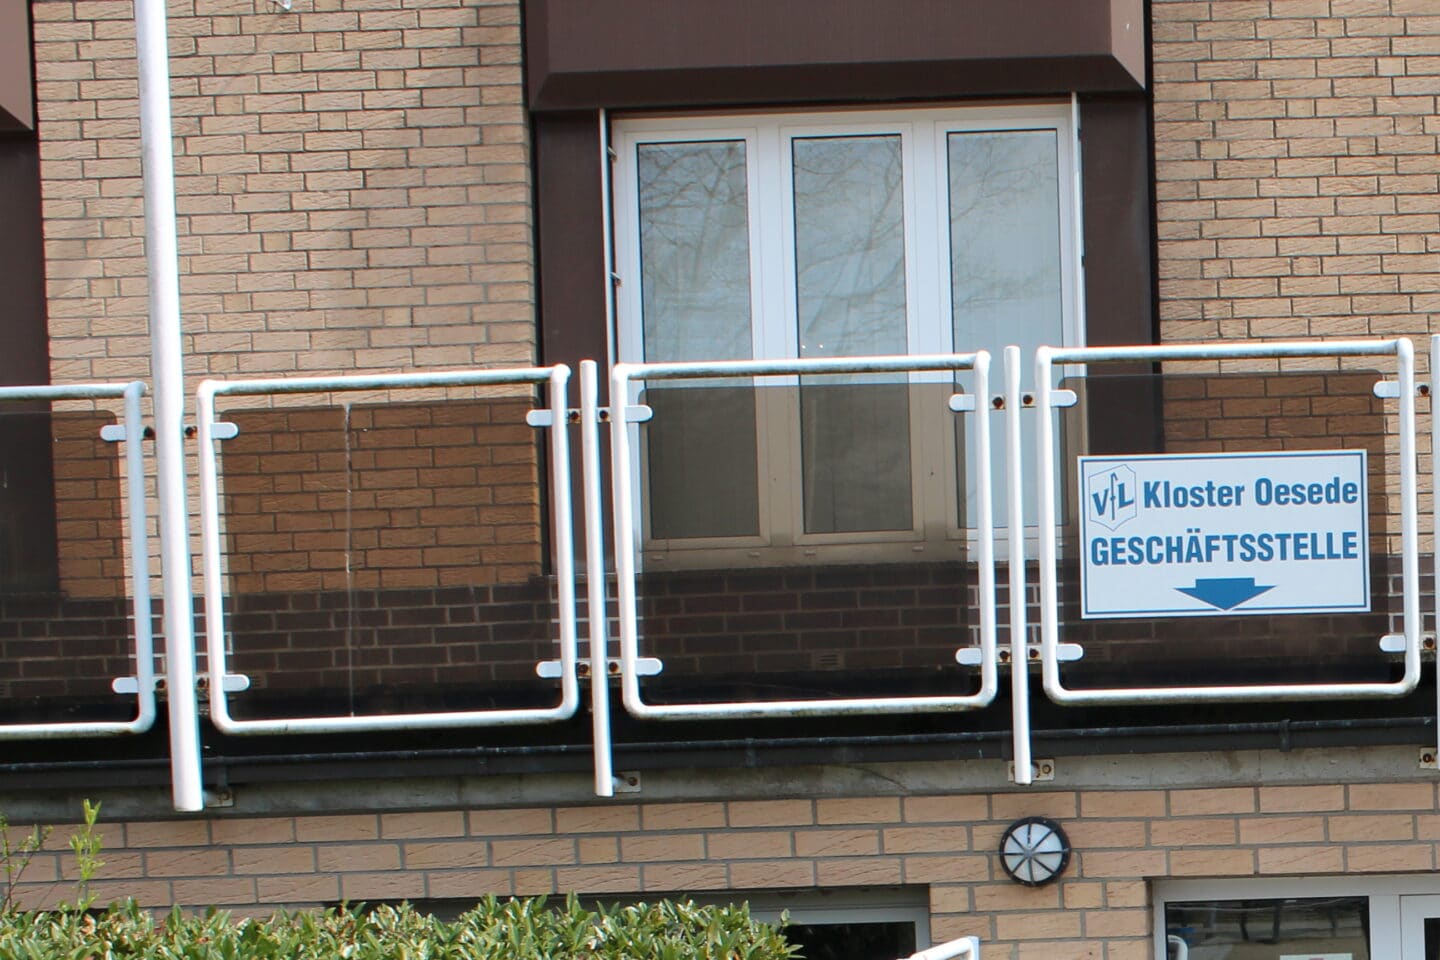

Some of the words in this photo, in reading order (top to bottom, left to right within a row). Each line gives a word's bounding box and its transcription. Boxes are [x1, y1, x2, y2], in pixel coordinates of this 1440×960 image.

[1143, 480, 1245, 508] Kloster
[1255, 476, 1358, 506] Oesede
[1091, 528, 1358, 566] GESCHÄFTSSTELLE
